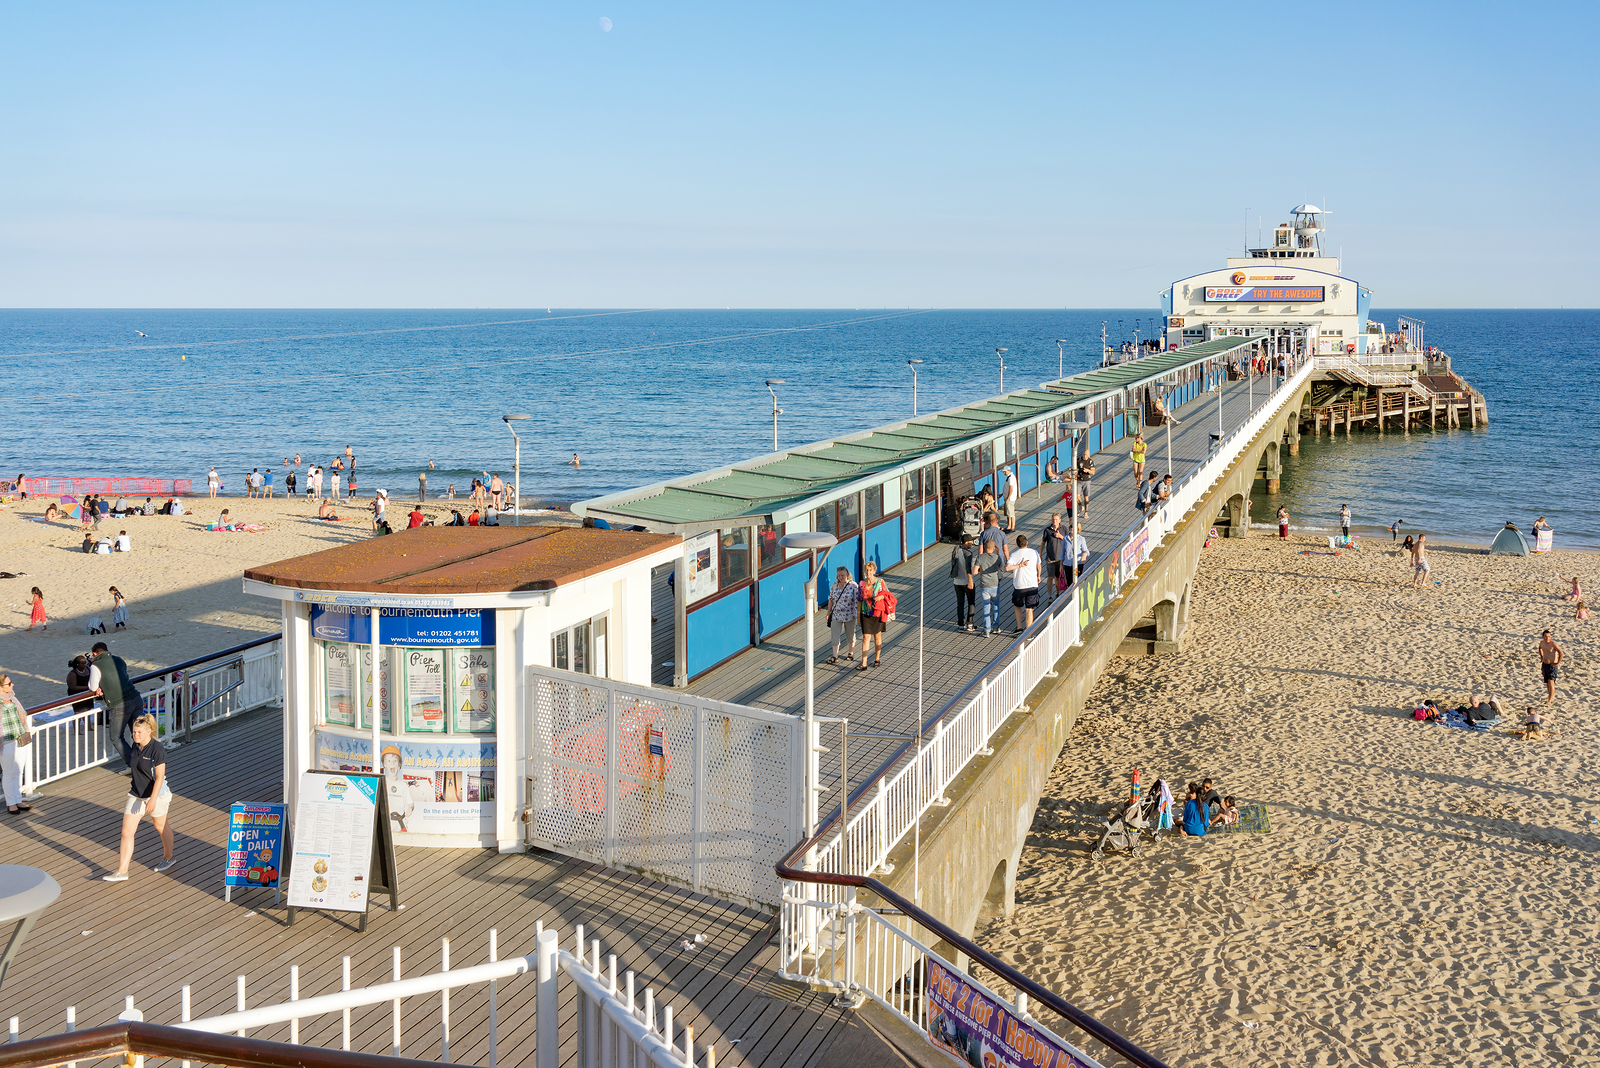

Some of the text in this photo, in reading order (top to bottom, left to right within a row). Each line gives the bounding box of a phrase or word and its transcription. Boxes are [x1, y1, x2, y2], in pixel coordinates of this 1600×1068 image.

[1253, 290, 1322, 298] TRY THE AWESOME
[318, 604, 482, 617] Welcome to ournemouth Pier
[329, 646, 347, 659] Pier
[410, 652, 435, 666] Pier
[459, 655, 488, 670] Safe
[425, 664, 440, 673] Toll
[321, 746, 349, 760] Adventure
[404, 757, 497, 767] All Ages, All Abilities!
[233, 812, 280, 826] FUN FAIR
[231, 830, 259, 842] OPEN
[248, 839, 276, 851] DAILY
[229, 850, 248, 859] WITH
[230, 860, 247, 868] NEW
[227, 868, 248, 877] RIDES
[930, 963, 958, 1003] Pier
[957, 984, 971, 1012] 2
[970, 992, 993, 1028] for
[997, 1009, 1004, 1036] 1
[1005, 1017, 1054, 1068] Happy
[1056, 1050, 1077, 1068] H
[943, 1000, 955, 1014] THESE
[955, 1010, 978, 1030] AWESOME
[978, 1025, 991, 1038] PIER
[993, 1034, 1021, 1062] EXPERIENCES
